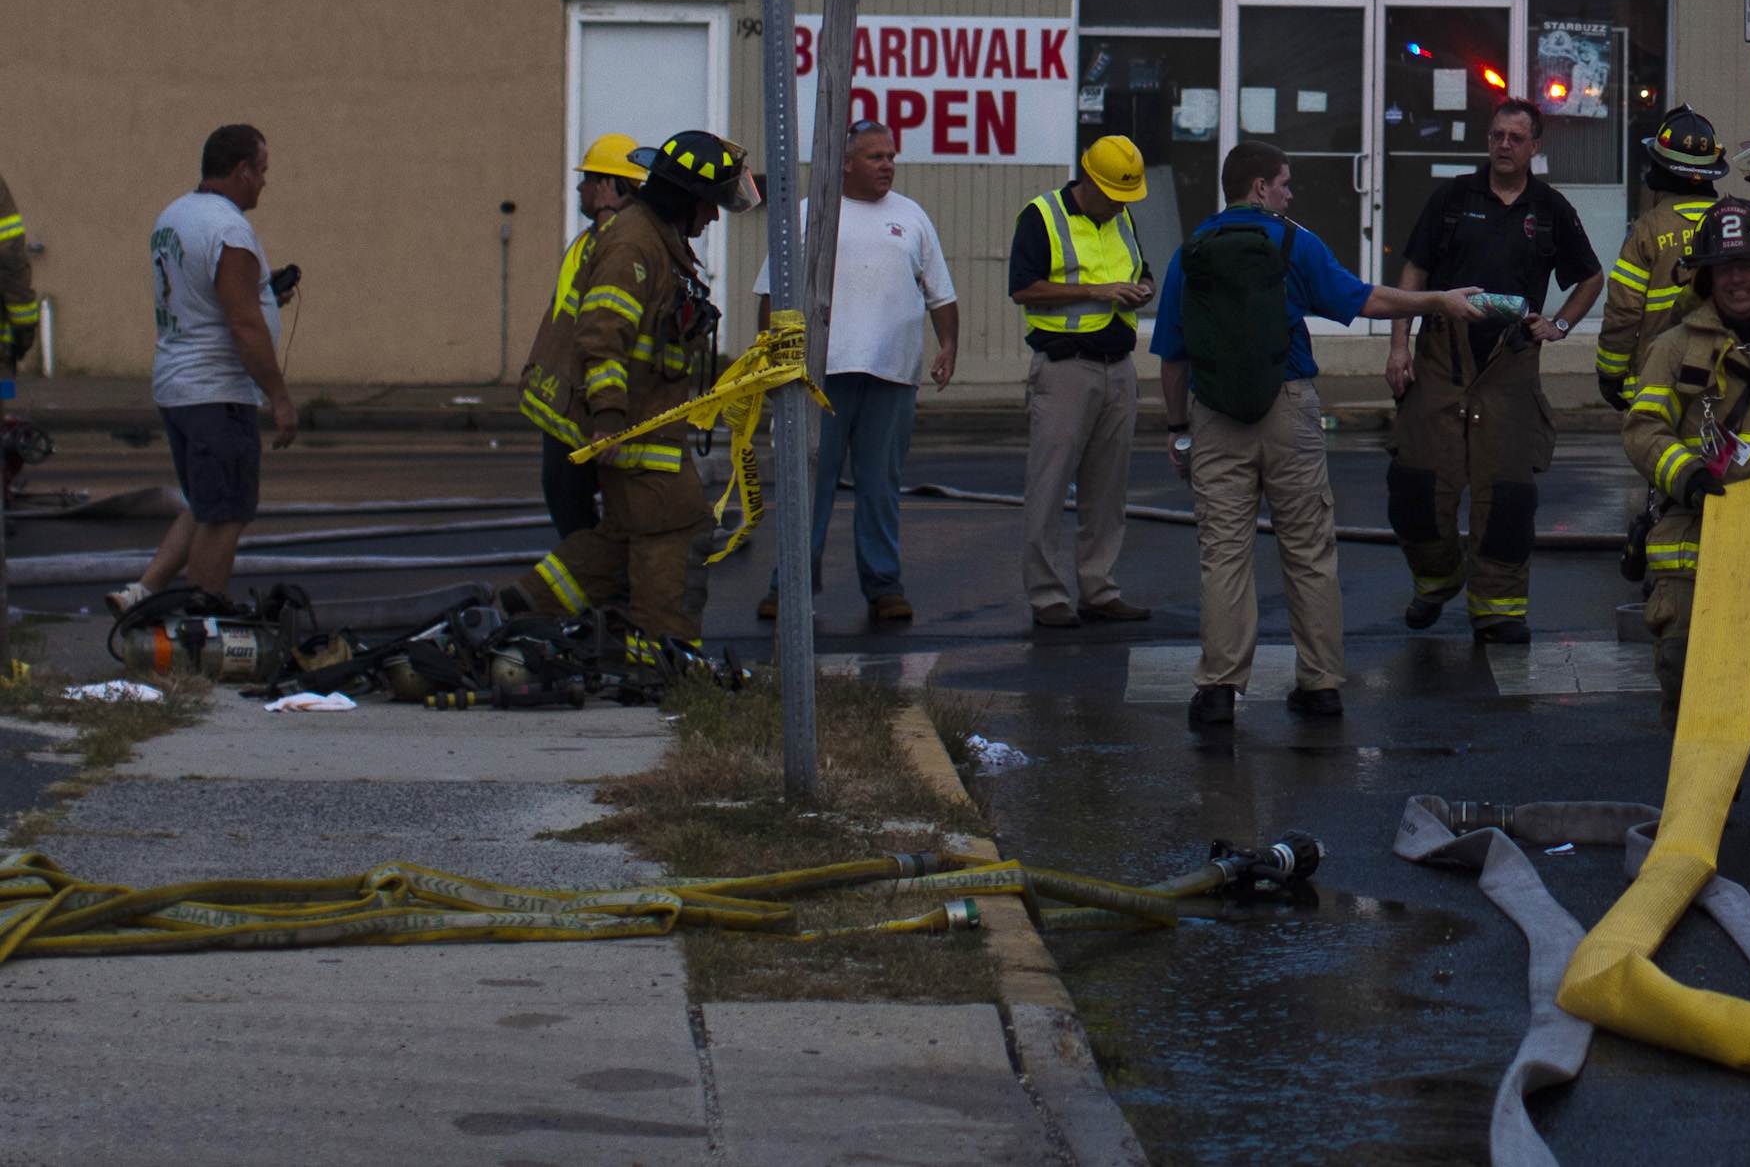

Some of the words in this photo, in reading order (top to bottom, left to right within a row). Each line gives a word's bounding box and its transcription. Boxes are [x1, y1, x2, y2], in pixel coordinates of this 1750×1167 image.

[1543, 21, 1607, 32] STARBUZZ
[795, 26, 1069, 79] BARDWALK
[1721, 215, 1741, 239] 2
[503, 894, 549, 914] EXIT
